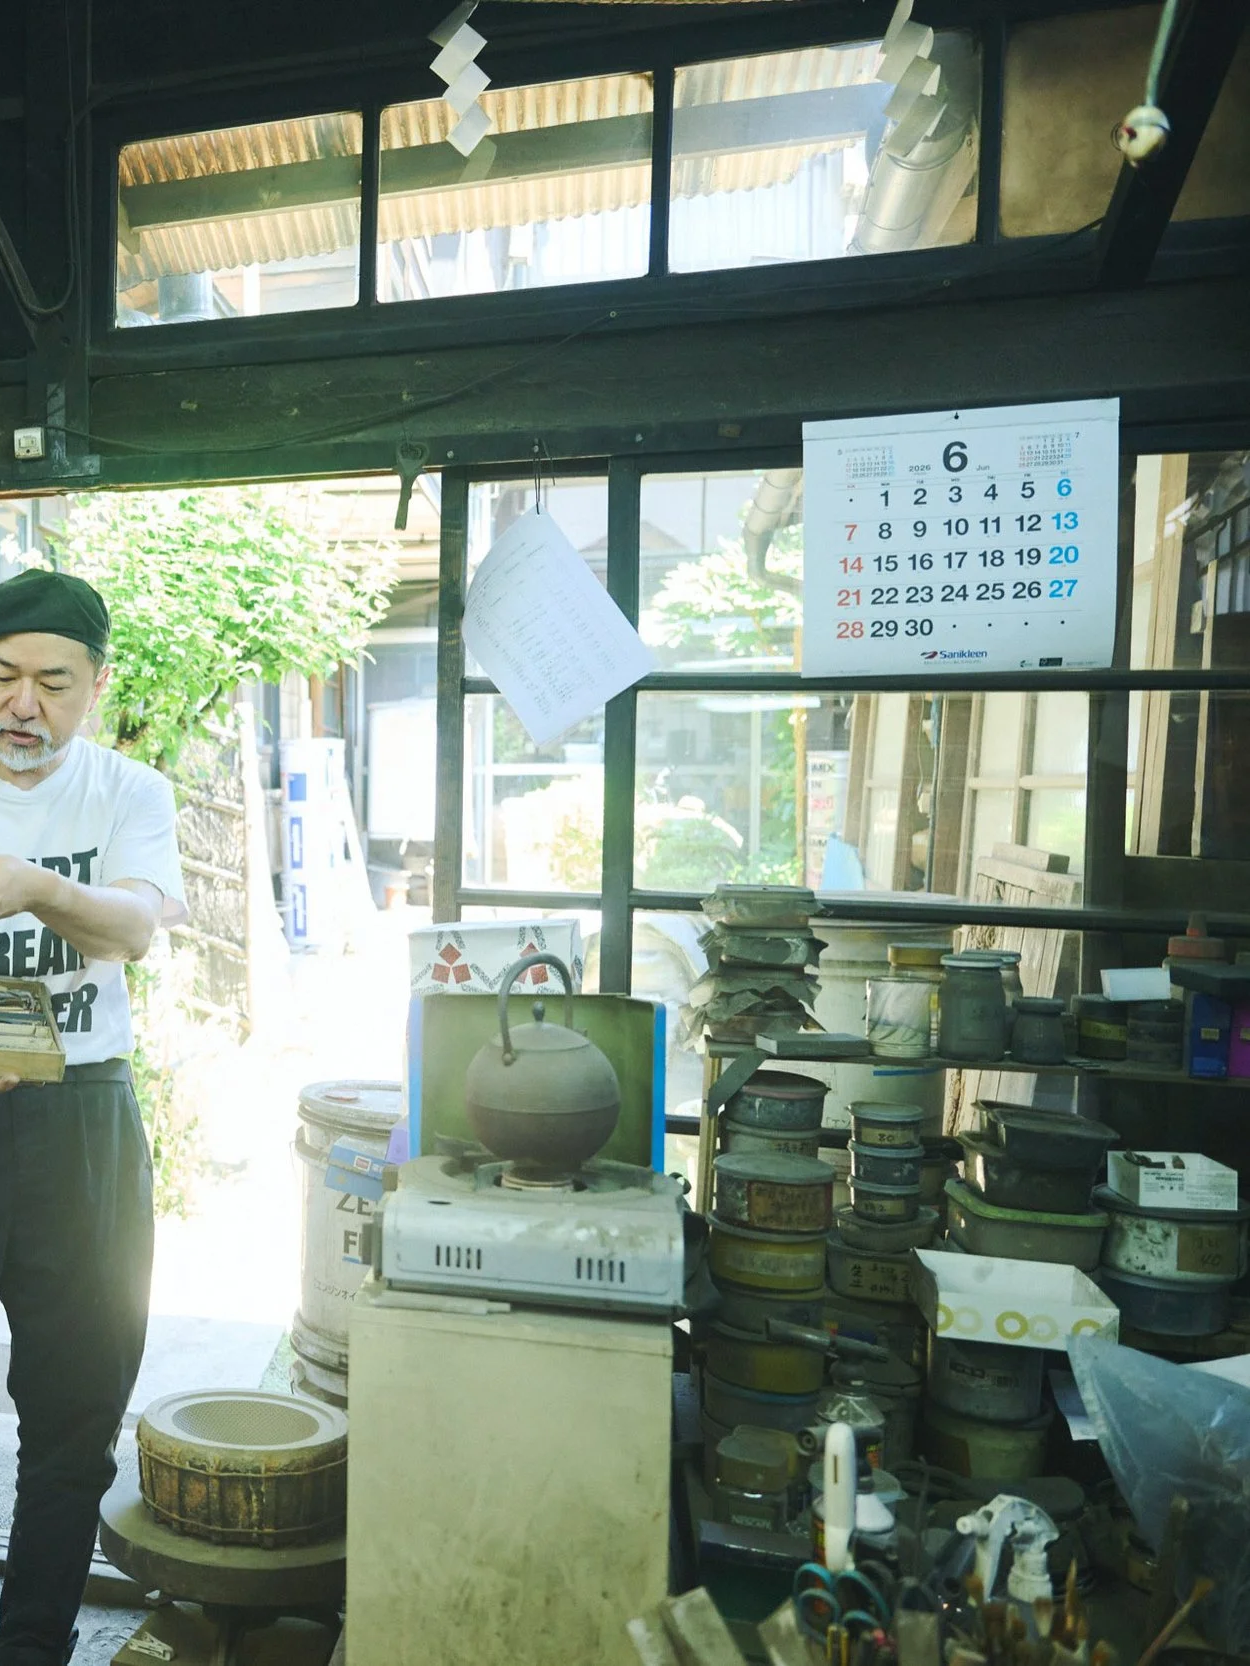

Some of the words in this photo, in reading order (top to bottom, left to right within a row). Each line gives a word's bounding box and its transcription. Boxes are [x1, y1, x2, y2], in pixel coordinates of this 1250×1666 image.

[909, 464, 931, 473] 2026
[943, 441, 968, 472] 6
[880, 490, 889, 507] 1
[914, 488, 927, 505] 2
[949, 486, 962, 503] 3
[984, 484, 998, 500] 4
[1021, 481, 1035, 498] 5
[1057, 478, 1072, 497] 6
[845, 525, 857, 541] 7
[879, 522, 892, 539] 8
[913, 521, 927, 537] 9
[943, 518, 969, 536] 10
[979, 516, 1000, 534] 11
[1015, 514, 1041, 532] 12
[1052, 512, 1078, 530] 13
[840, 557, 863, 573] 14
[873, 555, 898, 572] 15
[908, 553, 933, 570] 16
[944, 552, 967, 569] 17
[979, 550, 1004, 567] 18
[1015, 548, 1041, 565] 19
[1049, 545, 1079, 564] 20
[838, 589, 861, 606] 21
[871, 587, 898, 605] 22
[906, 586, 933, 603] 23
[941, 584, 969, 602] 24
[976, 583, 1005, 600] 25
[1013, 581, 1041, 599] 26
[1049, 579, 1078, 598] 27
[837, 622, 864, 638] 28
[871, 620, 898, 637] 29
[905, 619, 933, 636] 30
[939, 650, 987, 660] Sanikleen
[51, 982, 98, 1033] ER
